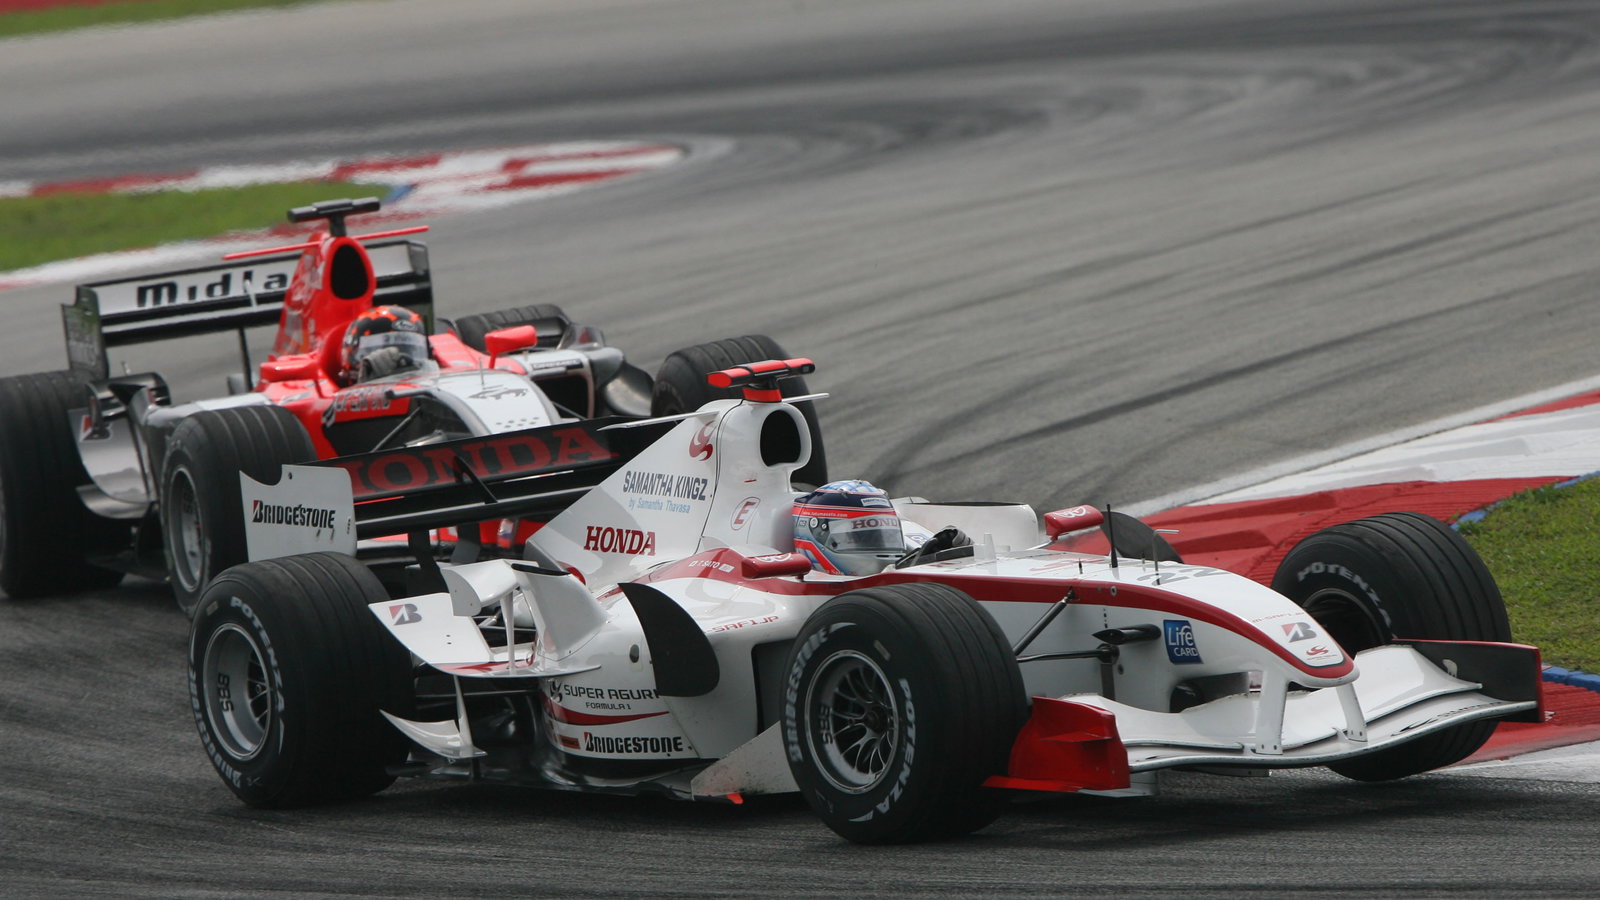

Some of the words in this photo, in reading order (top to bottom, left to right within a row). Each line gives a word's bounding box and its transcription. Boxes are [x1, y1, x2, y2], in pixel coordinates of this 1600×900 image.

[623, 470, 673, 496] SAMANTHA
[674, 475, 708, 501] KINGZ
[252, 499, 336, 529] BRIDGESTONE
[628, 498, 636, 511] by
[637, 498, 664, 511] Samantha
[666, 499, 691, 514] Thavasa
[583, 525, 656, 557] HONDA
[1136, 567, 1231, 586] 22
[1297, 561, 1392, 628] POTENZA
[1168, 625, 1194, 646] Life
[230, 595, 285, 713] POTENZA
[1174, 647, 1199, 657] CARD
[563, 684, 604, 699] SUPER
[585, 701, 626, 710] FORMULA
[583, 731, 684, 754] BRIDGESTONE
[876, 677, 916, 815] POTENZA
